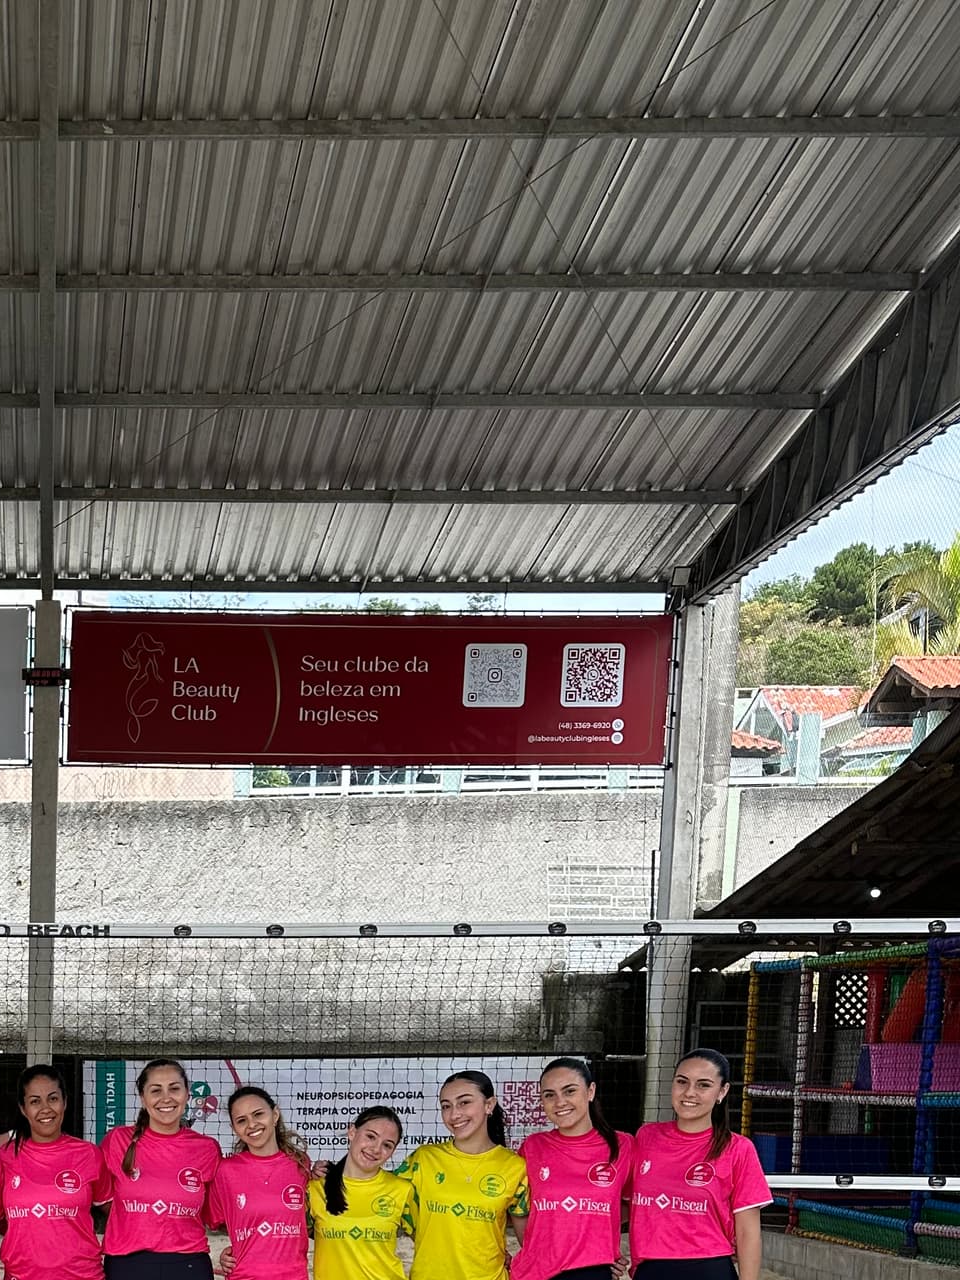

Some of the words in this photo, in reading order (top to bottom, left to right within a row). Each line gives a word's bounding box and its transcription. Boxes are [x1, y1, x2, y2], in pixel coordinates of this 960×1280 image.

[173, 656, 200, 673] LA
[300, 655, 339, 672] Seu
[344, 656, 399, 672] clube
[404, 656, 429, 672] da
[172, 680, 240, 703] Beauty
[300, 680, 364, 697] beleza
[369, 684, 401, 697] em
[171, 704, 217, 721] Club
[299, 706, 379, 726] Ingleses
[27, 924, 110, 937] BEACH
[106, 1073, 116, 1105] TDAH
[296, 1091, 424, 1101] NEUROPSICOPEDAGOGIA
[296, 1106, 339, 1115] TERAPIA
[106, 1111, 116, 1133] TEA
[47, 1205, 79, 1217] Fiscal
[122, 1199, 150, 1213] Valor
[578, 1198, 611, 1213] Fisca
[672, 1196, 708, 1213] Fiscal
[467, 1205, 497, 1221] Fiscal
[272, 1222, 302, 1235] Fiscal
[321, 1226, 347, 1240] Valor
[364, 1227, 393, 1240] Fiscal
